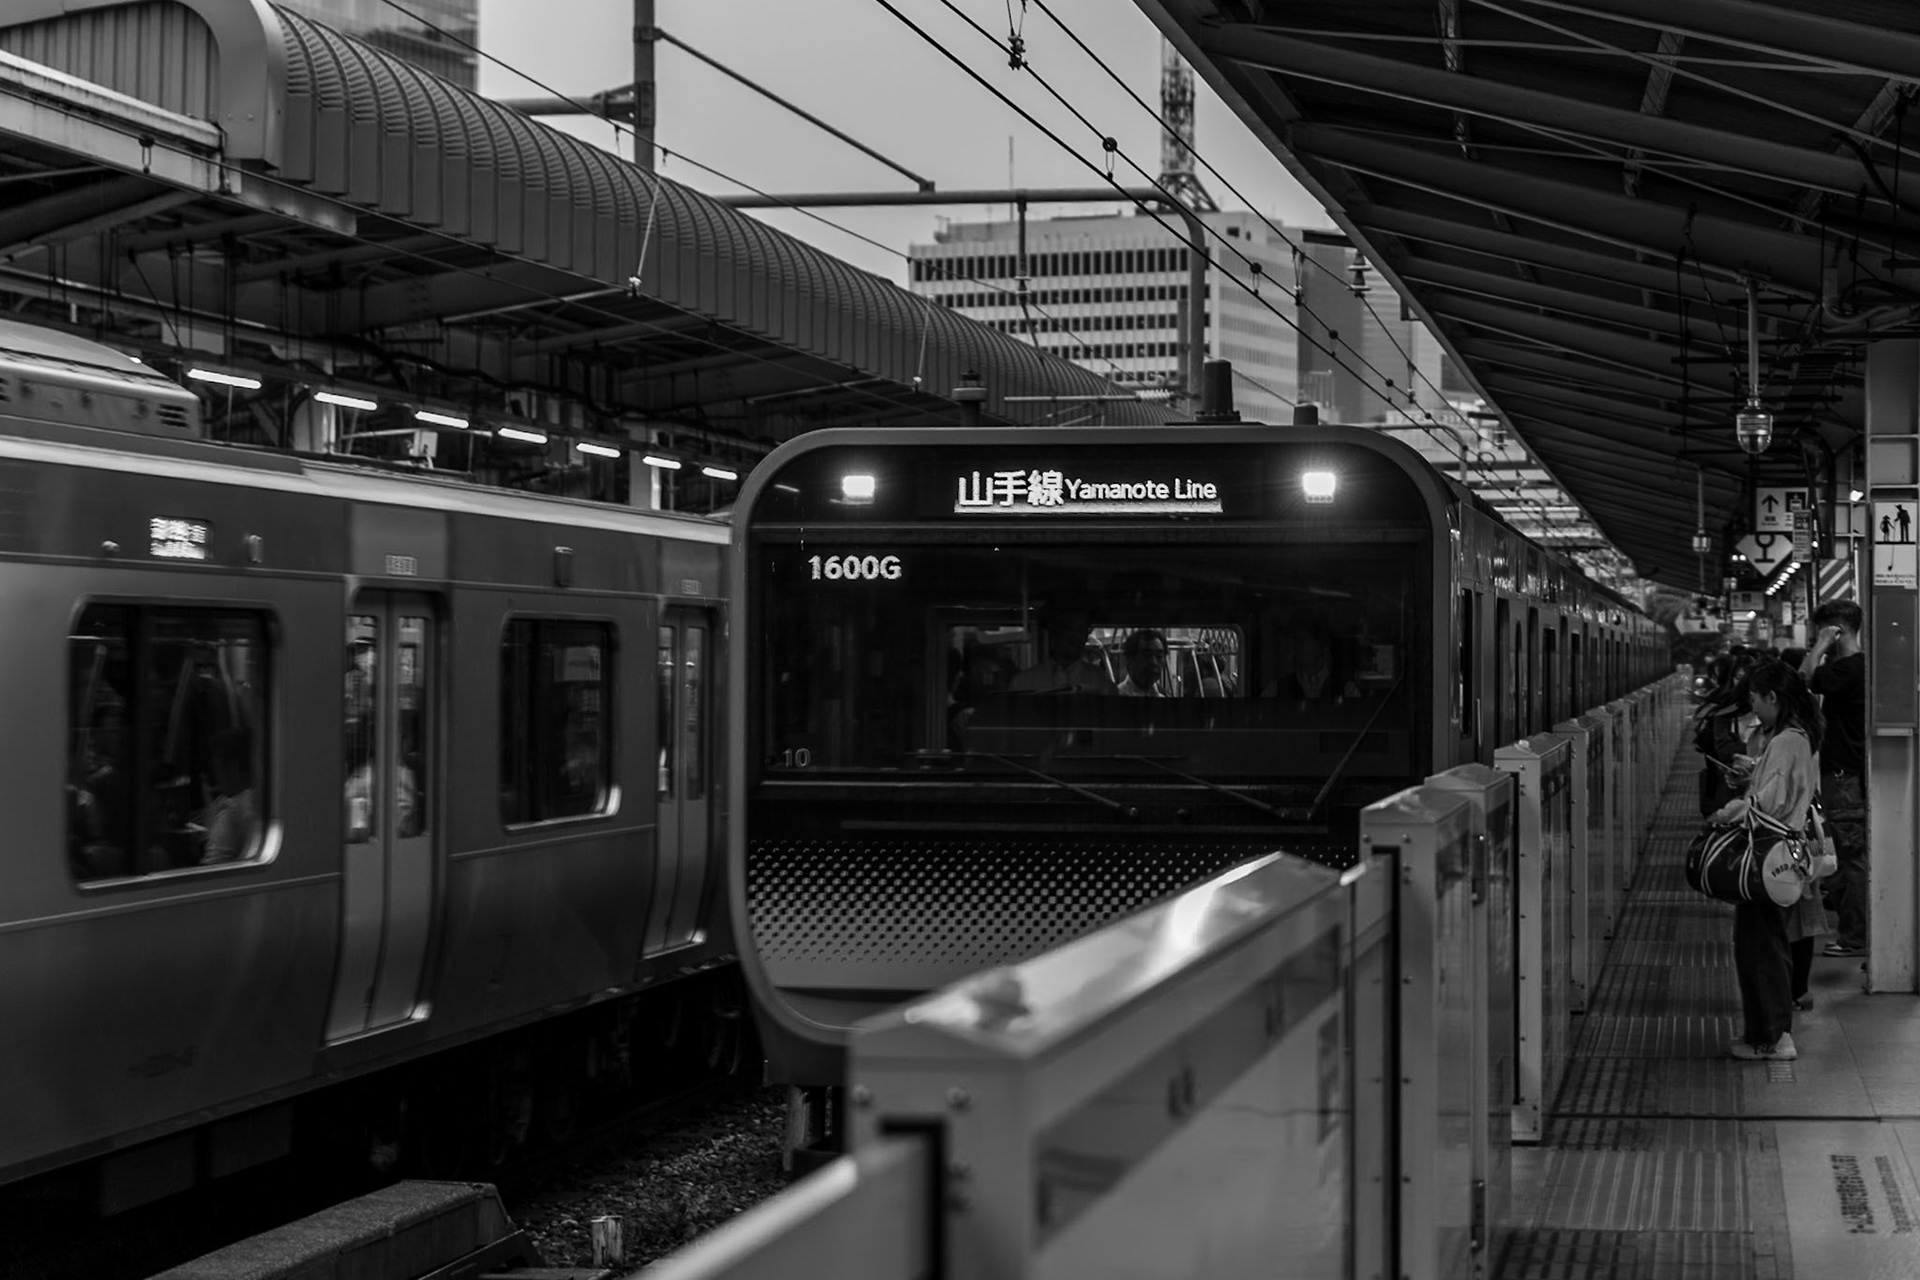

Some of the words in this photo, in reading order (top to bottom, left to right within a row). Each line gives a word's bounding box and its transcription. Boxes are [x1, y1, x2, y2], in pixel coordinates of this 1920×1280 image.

[958, 469, 1064, 506] 山手線
[1064, 478, 1170, 500] Yamanote
[1174, 478, 1217, 500] Line
[808, 555, 901, 580] 1600G
[782, 747, 811, 768] 10
